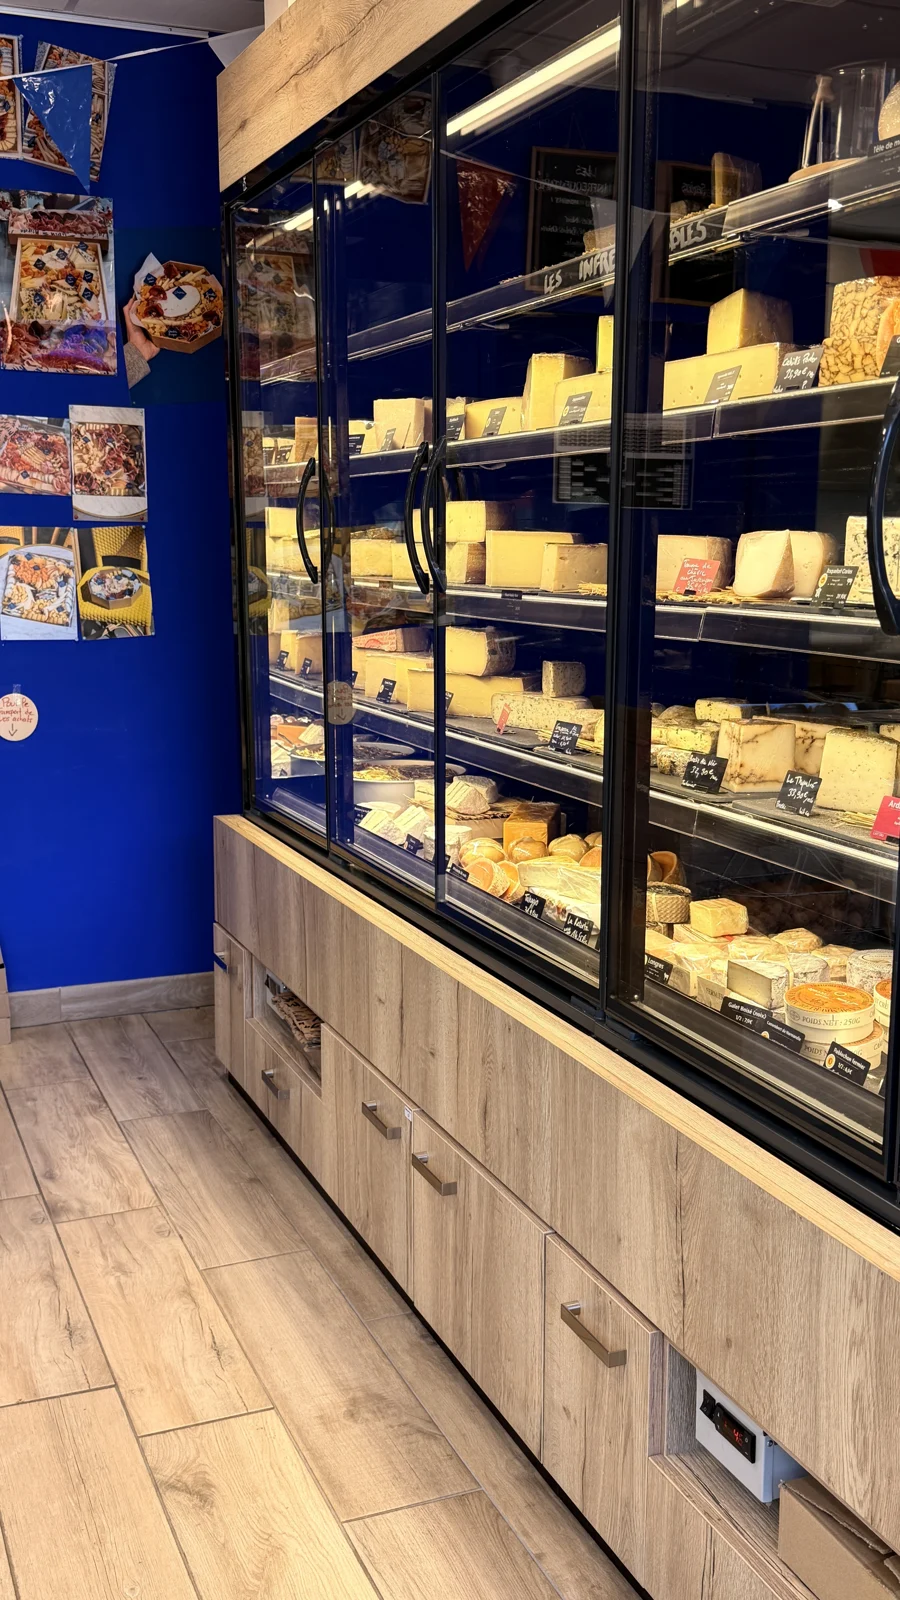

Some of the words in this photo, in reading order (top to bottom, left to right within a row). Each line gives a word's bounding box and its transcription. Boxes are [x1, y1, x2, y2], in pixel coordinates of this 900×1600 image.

[886, 142, 894, 150] de
[544, 269, 562, 295] LES
[24, 708, 34, 716] de
[786, 774, 794, 784] Le
[648, 958, 664, 970] Langres
[728, 1002, 740, 1010] Galet
[740, 1006, 752, 1015] Boisé
[802, 1016, 822, 1026] POIDS
[844, 1018, 860, 1026] 250G
[804, 1045, 822, 1055] POIDS
[834, 1047, 852, 1062] Reblochon
[852, 1058, 866, 1070] fermier
